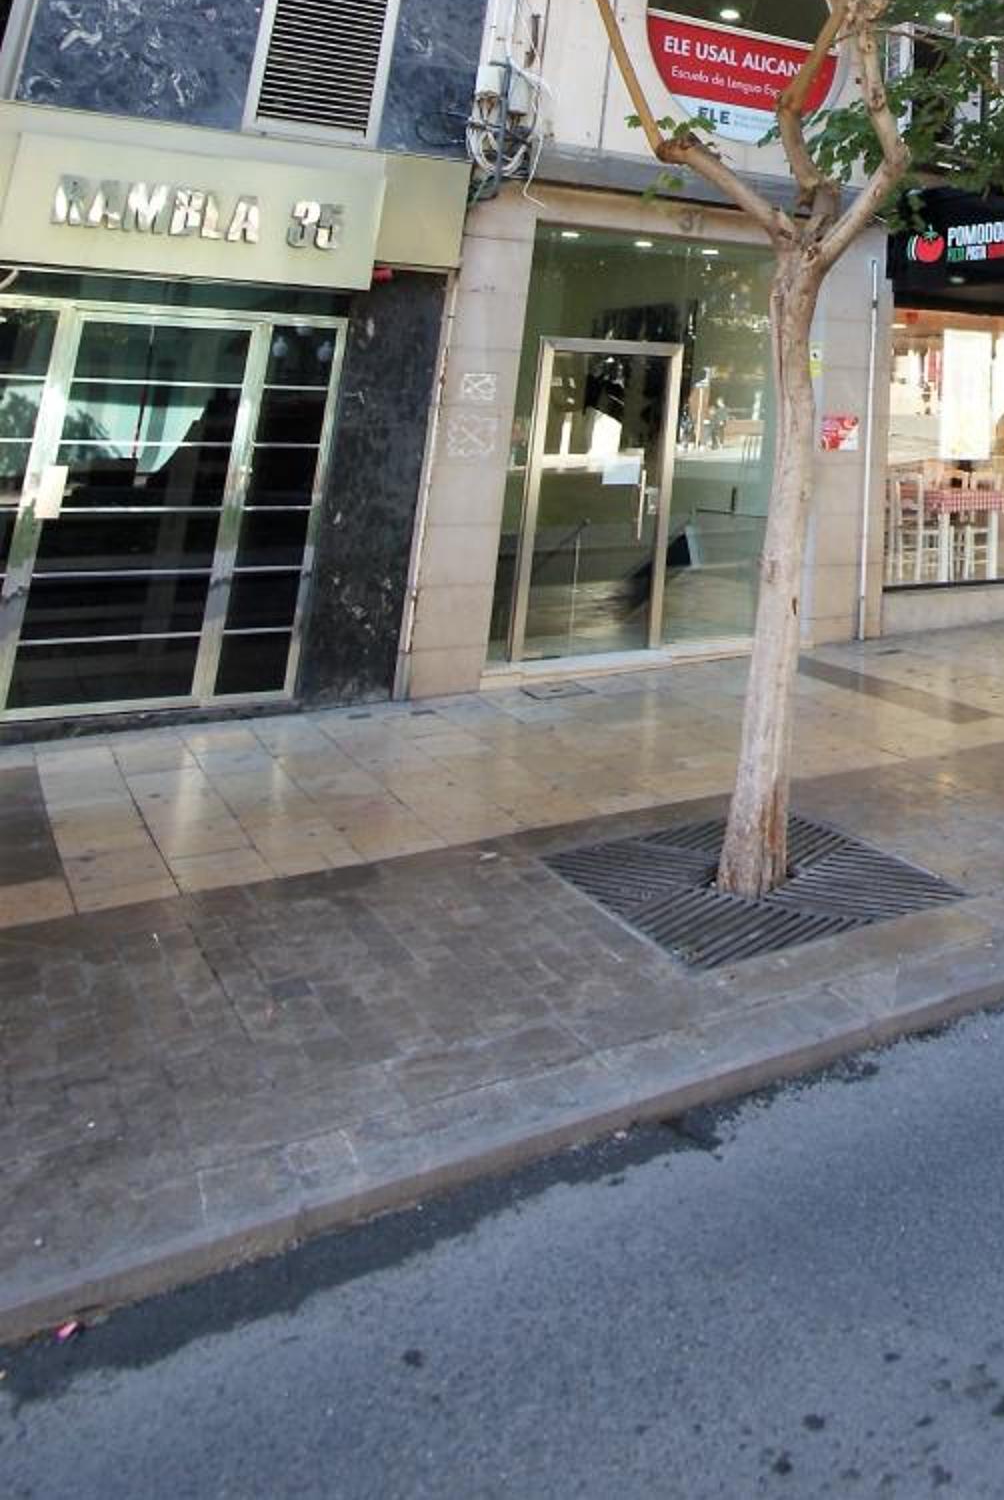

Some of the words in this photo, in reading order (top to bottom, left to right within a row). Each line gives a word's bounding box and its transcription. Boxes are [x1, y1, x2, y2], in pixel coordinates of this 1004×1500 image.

[664, 36, 691, 57] ELE
[695, 41, 738, 66] USAL
[741, 51, 804, 77] ALICAN
[672, 66, 709, 83] Escuela
[711, 72, 725, 87] de
[727, 76, 762, 94] Lengua
[52, 175, 260, 244] RAMBLA
[287, 200, 345, 250] 35
